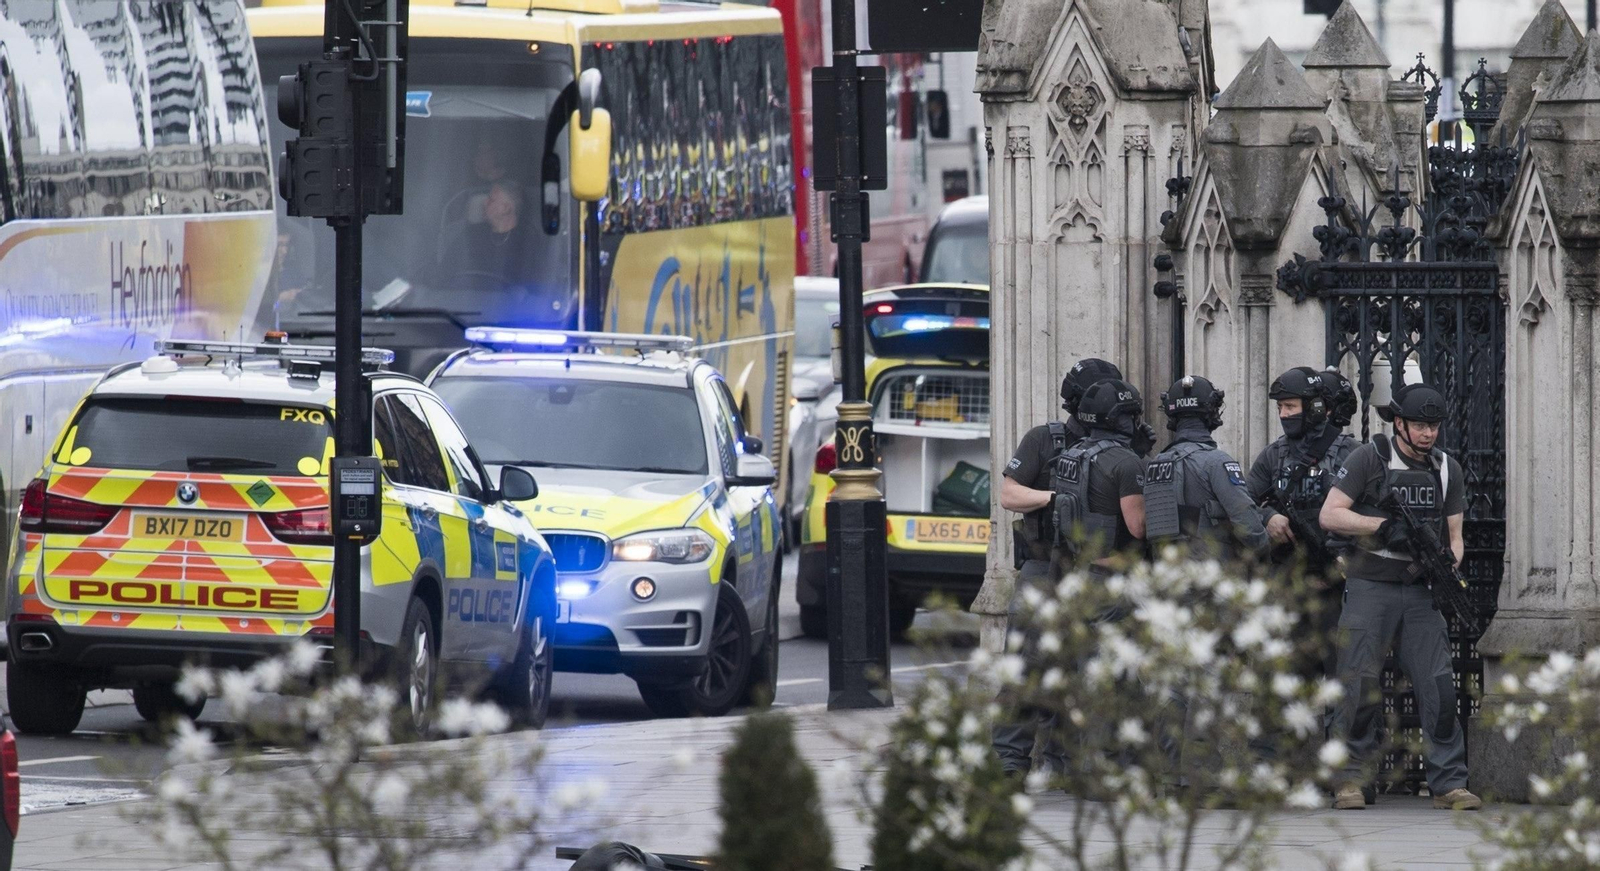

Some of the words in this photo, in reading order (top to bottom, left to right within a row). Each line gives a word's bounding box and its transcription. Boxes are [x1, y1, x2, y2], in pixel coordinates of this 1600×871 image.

[110, 239, 193, 355] Heyfordian
[1176, 397, 1199, 408] POLICE
[280, 408, 325, 425] FXQ
[1081, 411, 1097, 423] POLICE
[145, 517, 188, 537] BX17
[193, 518, 232, 538] DZO
[917, 522, 960, 538] LX65
[966, 524, 991, 540] AG
[69, 580, 299, 610] POLICE
[447, 588, 513, 622] POLICE
